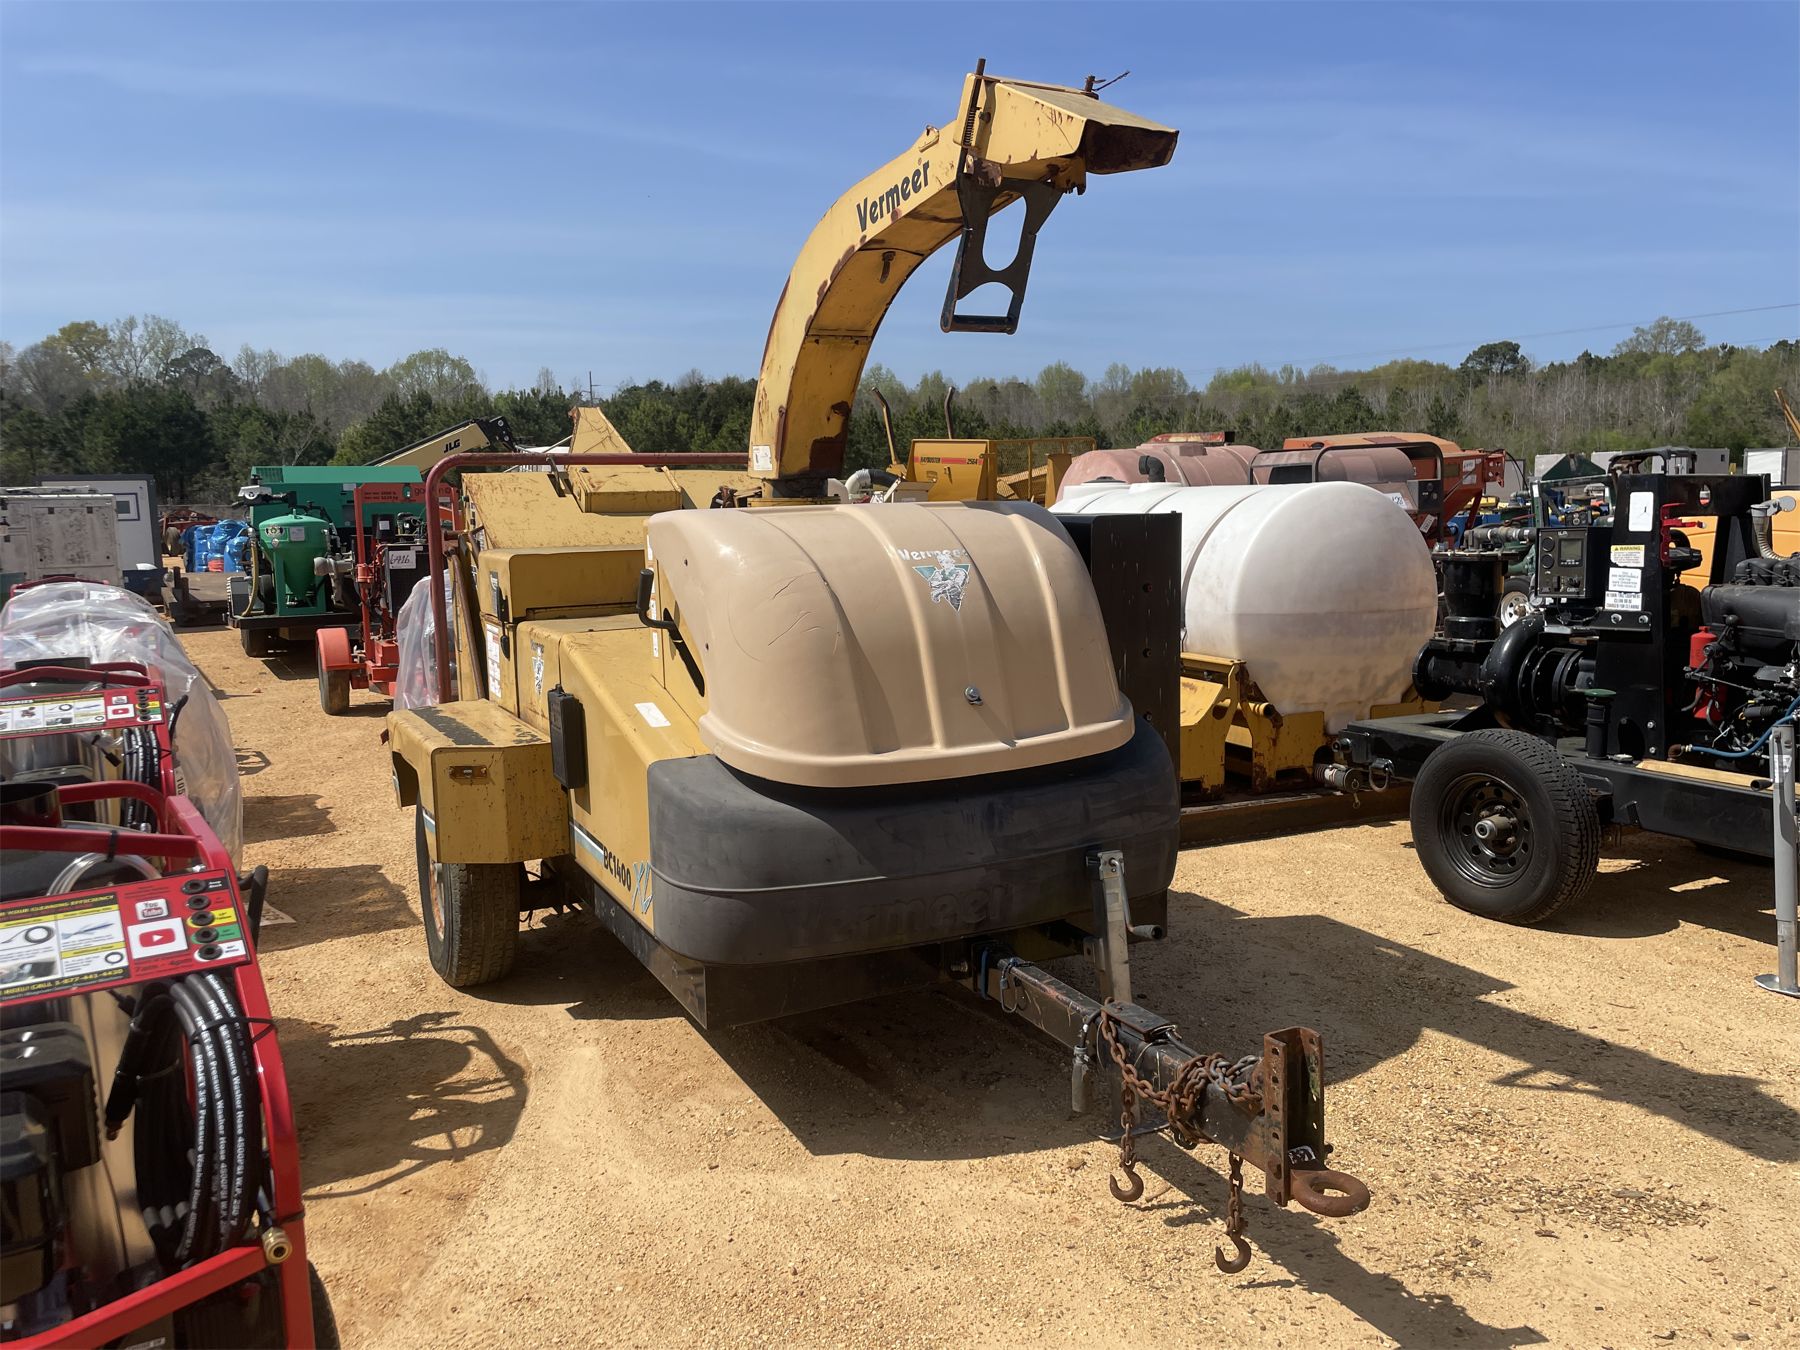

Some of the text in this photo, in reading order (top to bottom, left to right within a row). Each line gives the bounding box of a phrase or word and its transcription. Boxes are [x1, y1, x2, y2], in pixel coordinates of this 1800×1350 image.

[856, 160, 930, 233] Vermeer
[444, 439, 460, 453] JLG
[603, 846, 654, 914] BC1400 XL
[194, 1054, 207, 1088] PROJET
[224, 1039, 238, 1076] Pressure
[209, 1060, 222, 1099] Pressure
[232, 1075, 243, 1109] Washer
[198, 1109, 207, 1152] Pressure
[216, 1099, 226, 1135] Washer
[236, 1110, 245, 1136] Hose
[218, 1136, 228, 1161] Hose
